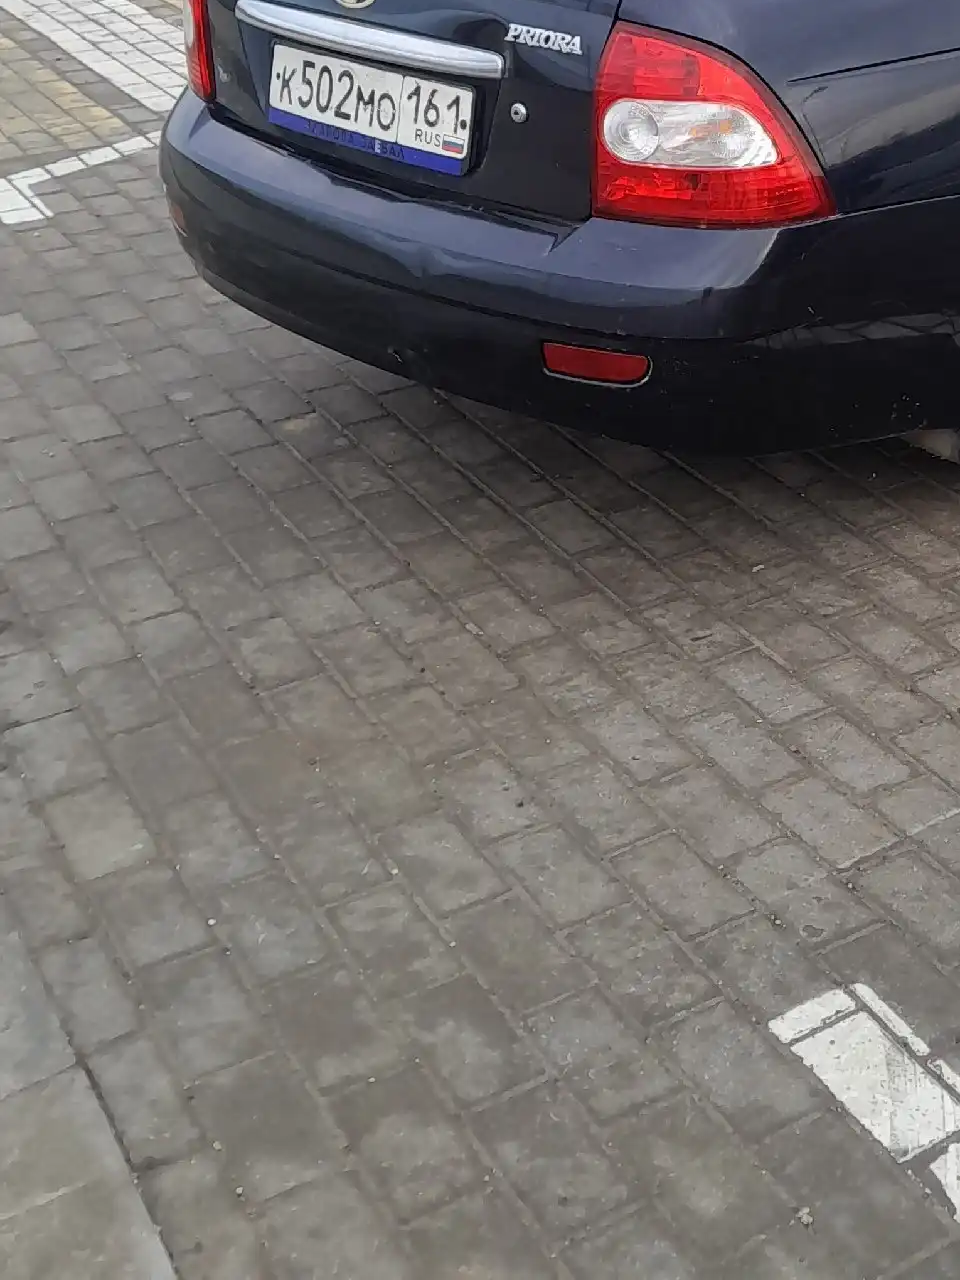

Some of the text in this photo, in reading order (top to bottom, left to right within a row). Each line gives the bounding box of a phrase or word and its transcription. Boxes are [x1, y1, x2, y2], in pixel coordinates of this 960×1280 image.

[503, 22, 583, 56] PRIORA
[406, 81, 461, 135] 161
[414, 128, 441, 148] RUS
